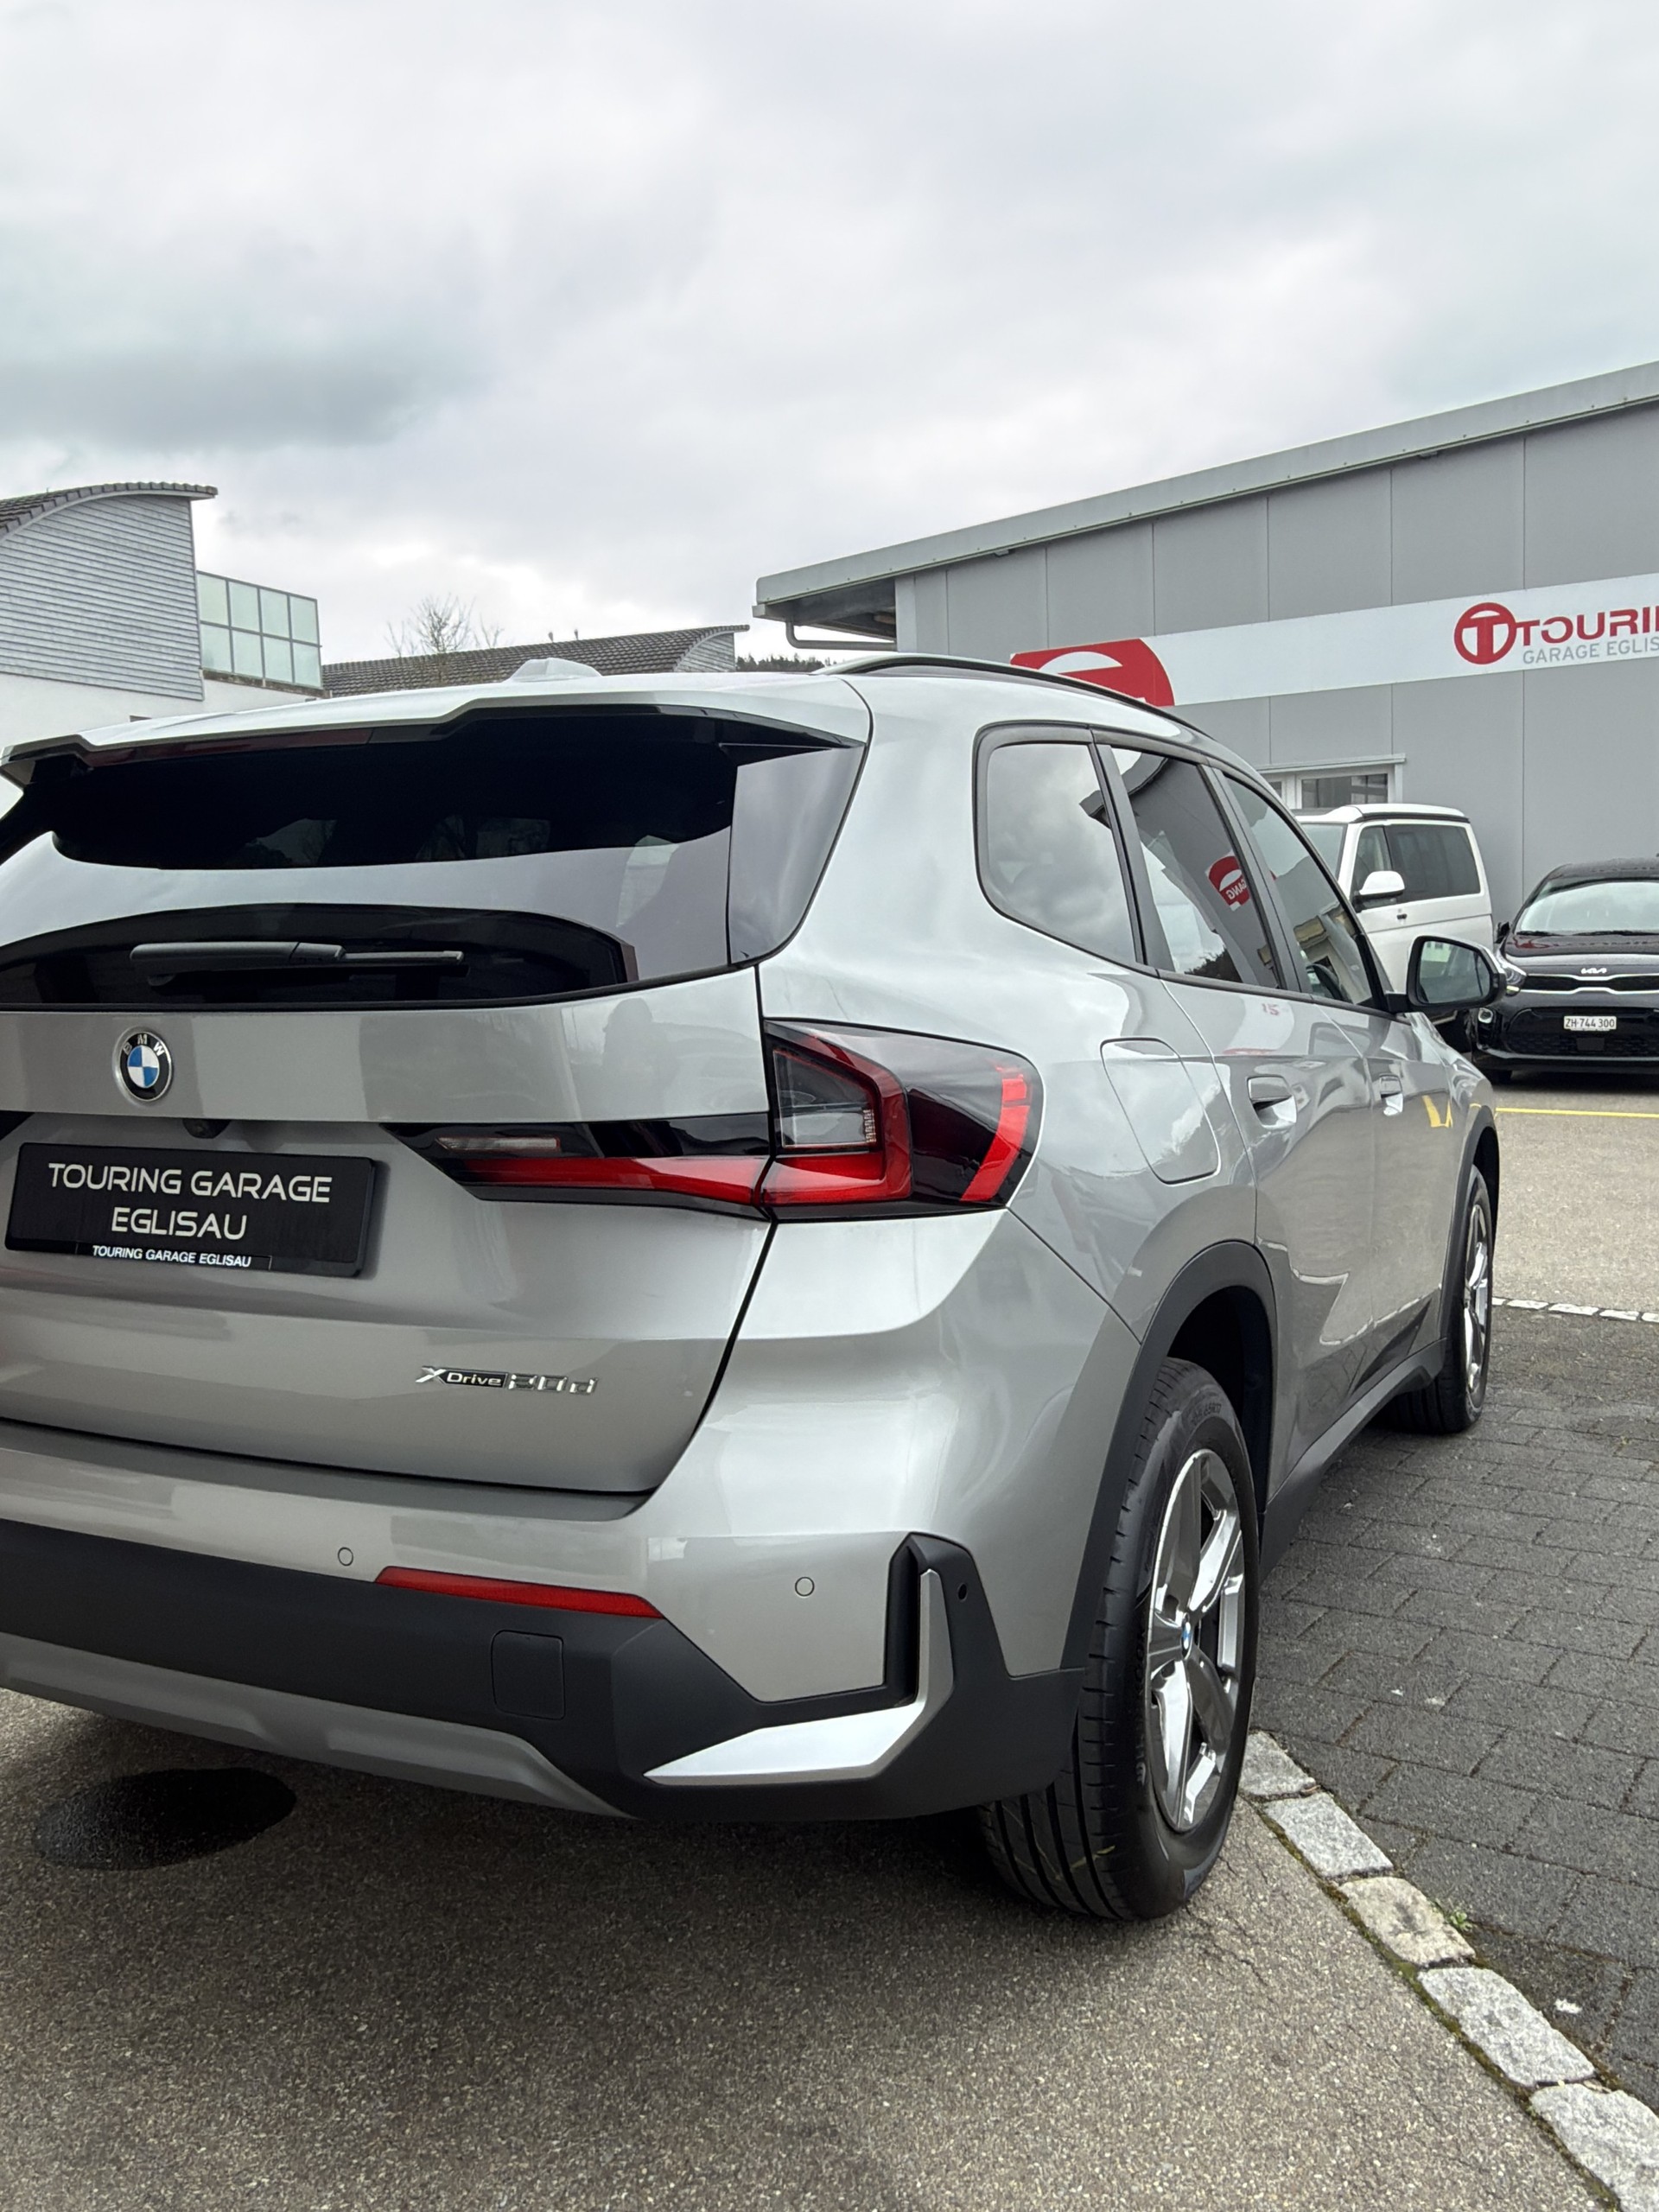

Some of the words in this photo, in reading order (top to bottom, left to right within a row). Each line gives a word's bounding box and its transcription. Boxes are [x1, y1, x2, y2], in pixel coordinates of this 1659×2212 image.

[1522, 644, 1599, 664] GARAGE
[1580, 1018, 1596, 1028] 744
[1598, 1018, 1615, 1028] 300
[123, 1033, 165, 1057] BMW
[48, 1162, 181, 1195] TOURING
[190, 1170, 333, 1204] GARAGE
[111, 1207, 248, 1241] EGLISAU
[92, 1245, 143, 1260] TOURING
[145, 1250, 196, 1264] GARAGE
[199, 1254, 251, 1268] EGLISAU
